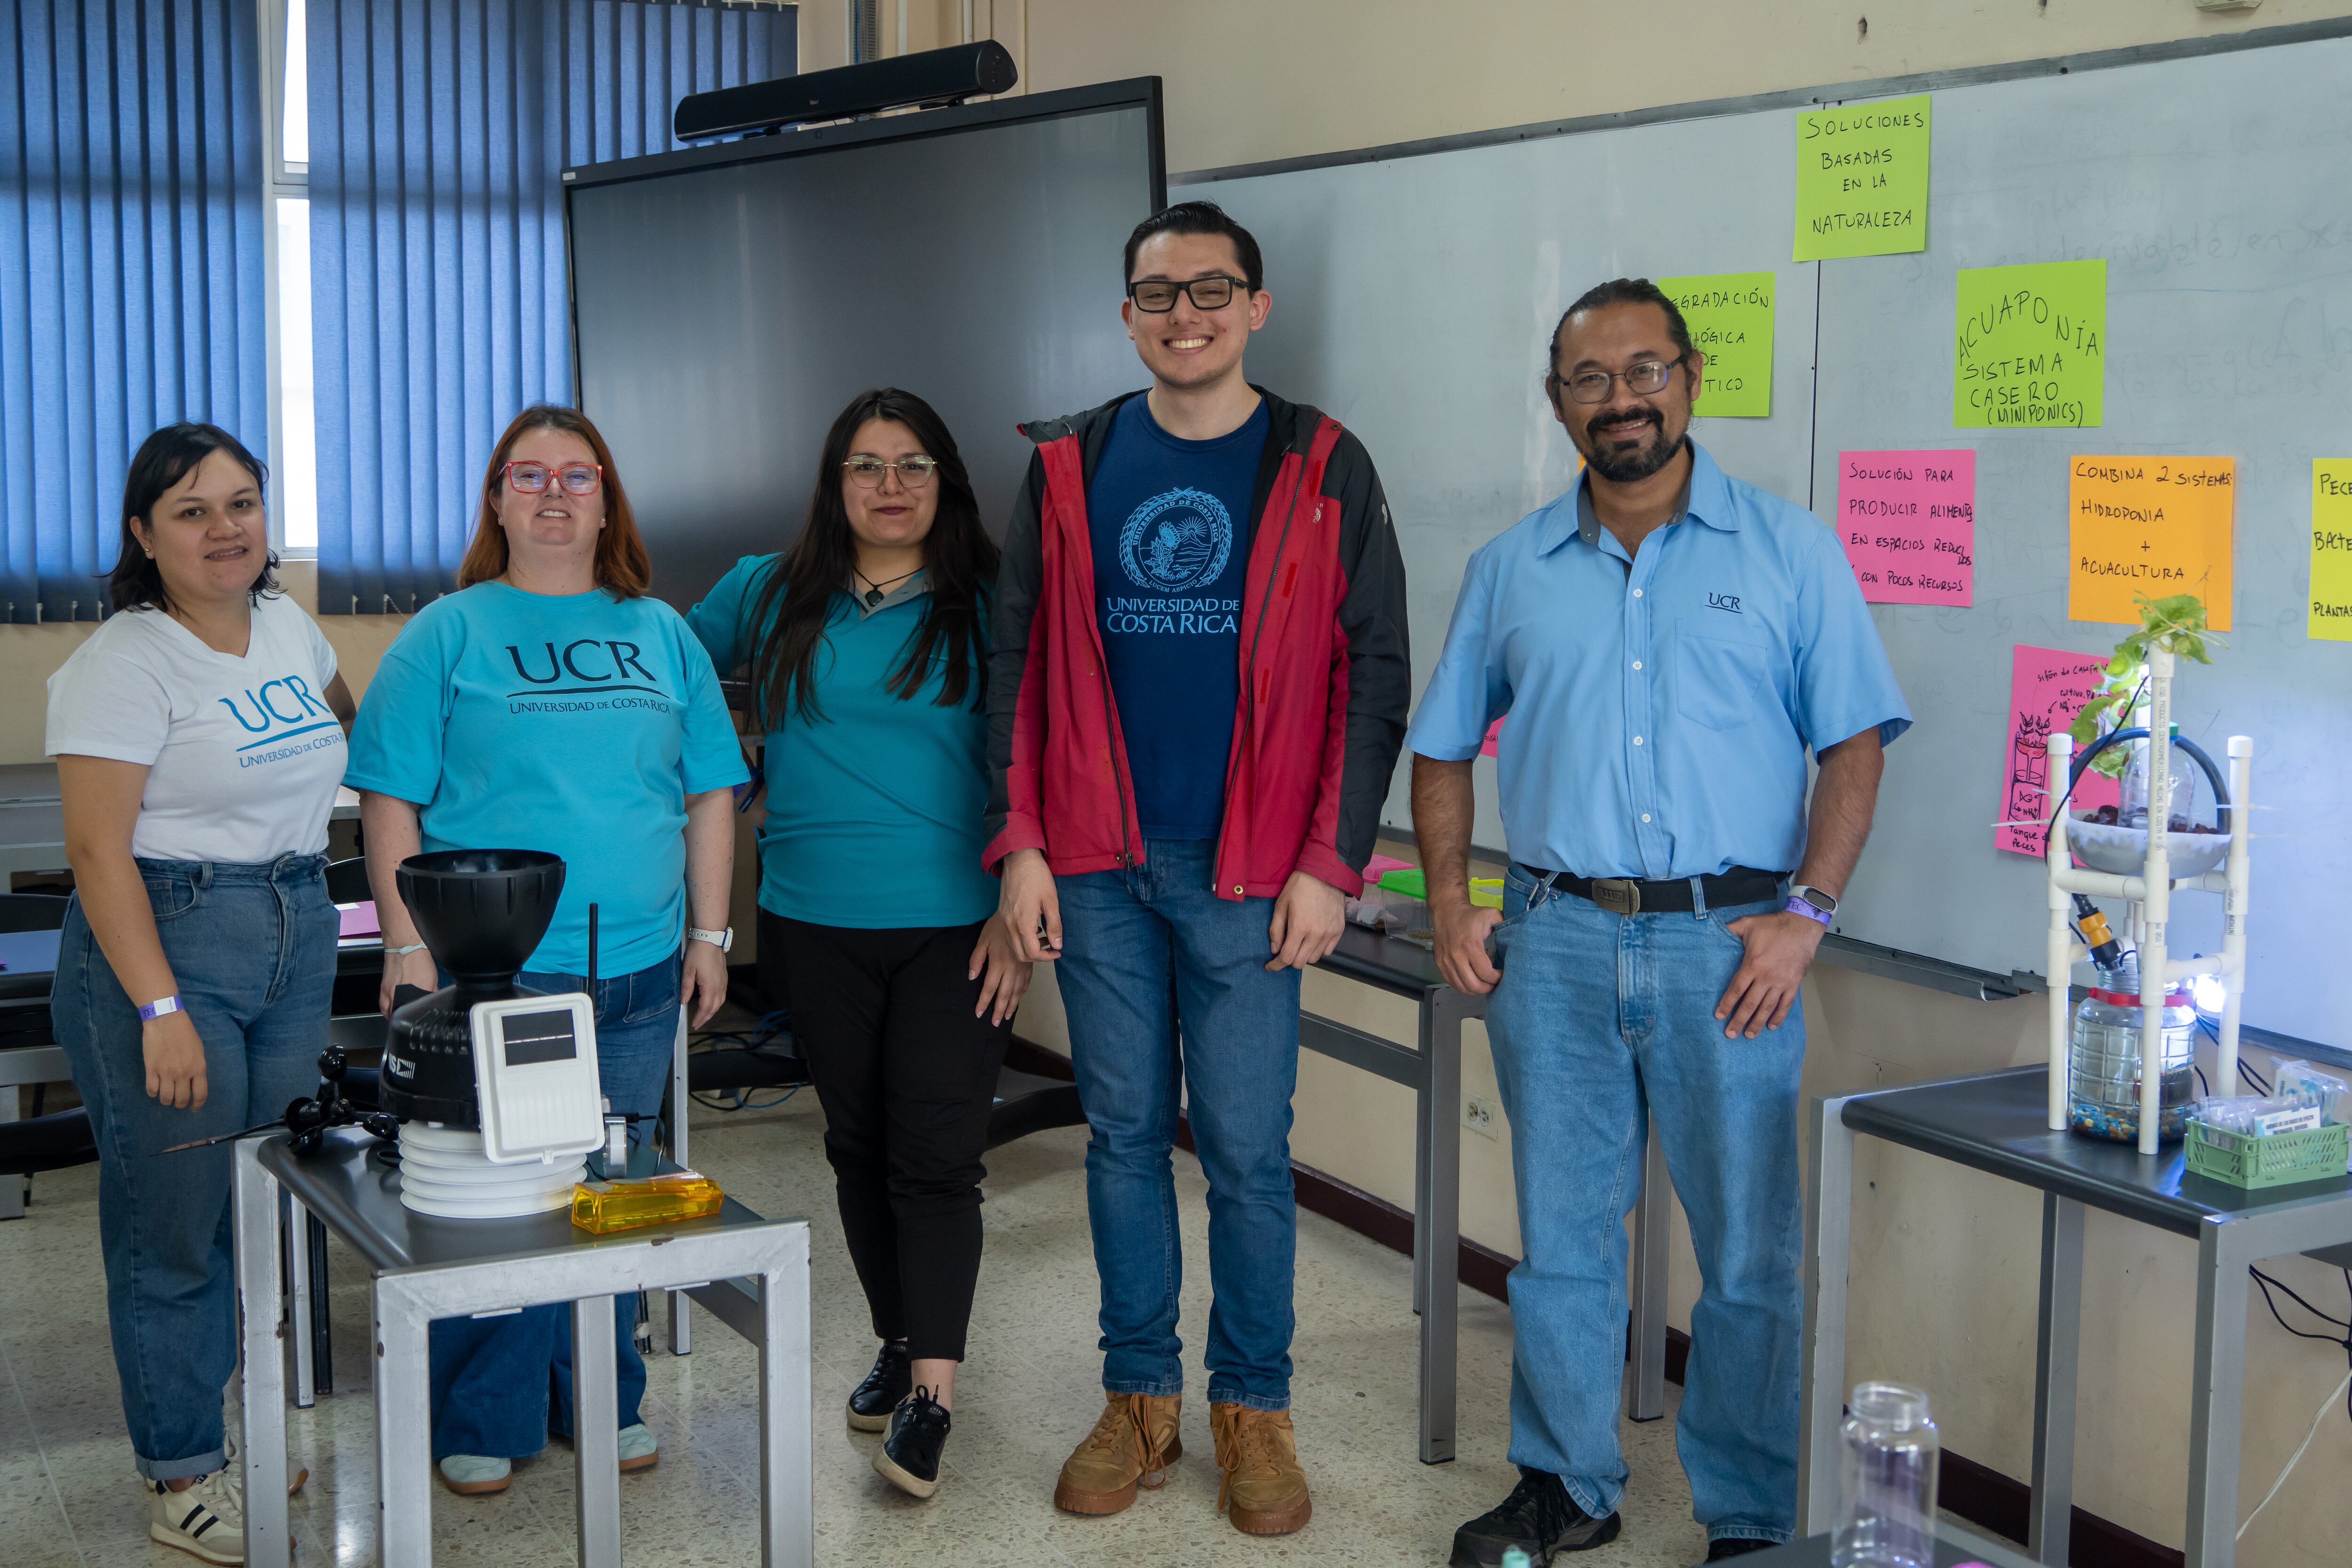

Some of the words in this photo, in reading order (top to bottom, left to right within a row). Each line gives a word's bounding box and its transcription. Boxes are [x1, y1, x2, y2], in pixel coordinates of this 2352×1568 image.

[1805, 113, 1924, 139] SOLUCIONES
[1821, 149, 1892, 170] BASADAS
[1843, 178, 1861, 191] EN
[1873, 173, 1887, 188] LA
[1813, 209, 1911, 235] NATURALEZA
[1671, 287, 1768, 310] EGRADACIÓN
[1963, 353, 2062, 381] SISTEMA
[1705, 378, 1743, 392] TICO
[1971, 382, 2058, 408] CASERO
[1925, 468, 1953, 482] PARA
[2076, 462, 2143, 483] COMBINA
[2156, 466, 2169, 482] 2
[1850, 499, 1917, 516] PRODUCIR
[1133, 501, 1176, 546] UNIVERSIDAD
[1193, 502, 1216, 521] COSTA
[1851, 533, 1868, 545] EN
[1875, 537, 1924, 553] ESPACIOS
[2081, 557, 2184, 580] ACUACULTURA
[1149, 580, 1169, 593] LUCEM
[1172, 579, 1197, 593] ASPICIO
[1861, 572, 1878, 583] CON
[1887, 570, 1913, 586] POCOS
[1919, 574, 1963, 591] RECURSOS
[1107, 597, 1219, 612] UNIVERSIDAD
[1222, 600, 1240, 611] DE
[1709, 592, 1740, 610] UCR
[1107, 613, 1175, 633] COSTA
[1180, 613, 1238, 634] RICA
[505, 639, 657, 684] UCR
[218, 675, 331, 732] UCR
[509, 701, 595, 714] UNIVERSIDAD
[596, 701, 610, 709] DE
[612, 698, 650, 708] COSTA
[651, 700, 670, 715] RICA
[239, 746, 302, 768] UNIVERSIDAD
[303, 743, 312, 752] DE
[313, 734, 340, 749] COSTA
[2009, 825, 2038, 841] Tanque
